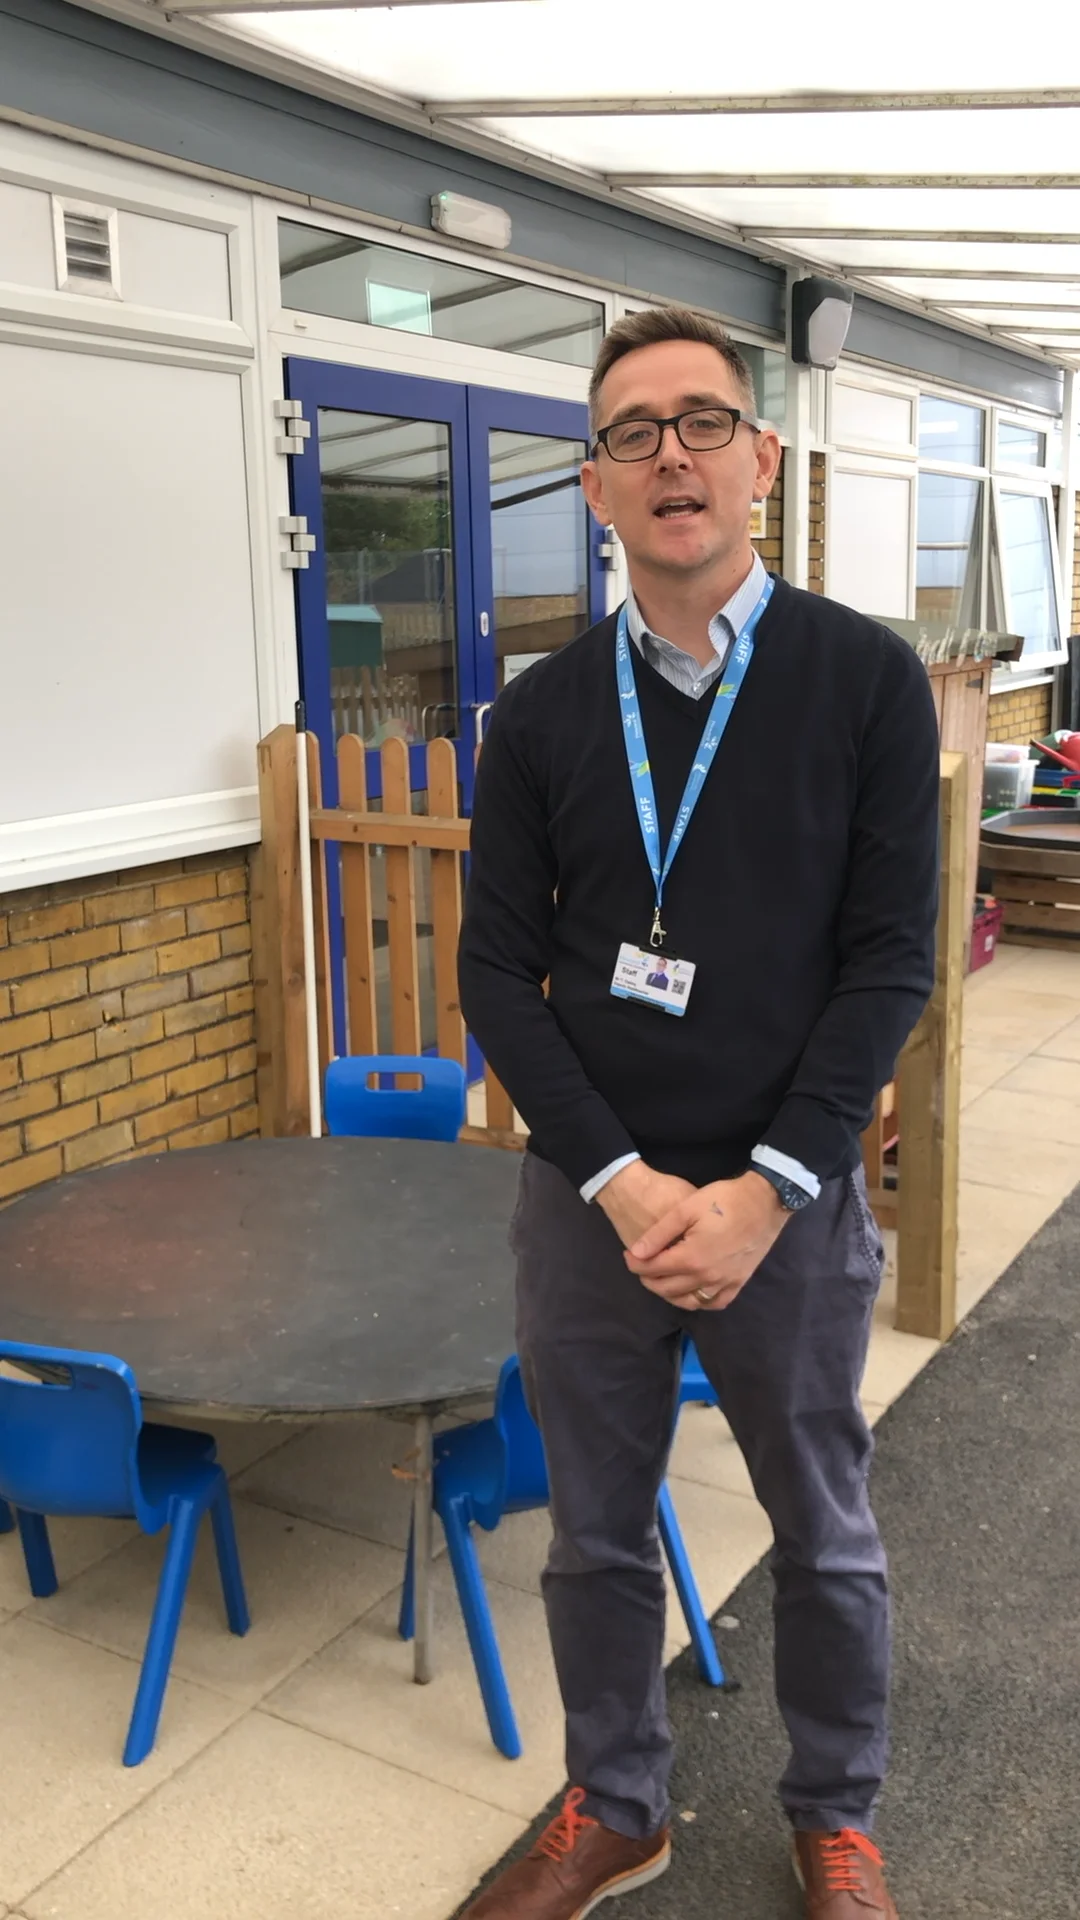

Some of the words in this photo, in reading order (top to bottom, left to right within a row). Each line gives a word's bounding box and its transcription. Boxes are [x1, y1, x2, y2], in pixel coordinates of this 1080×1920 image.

[735, 632, 750, 665] STAFF
[640, 797, 655, 834] STAFF
[673, 806, 690, 842] STAFF
[621, 967, 638, 977] Staff
